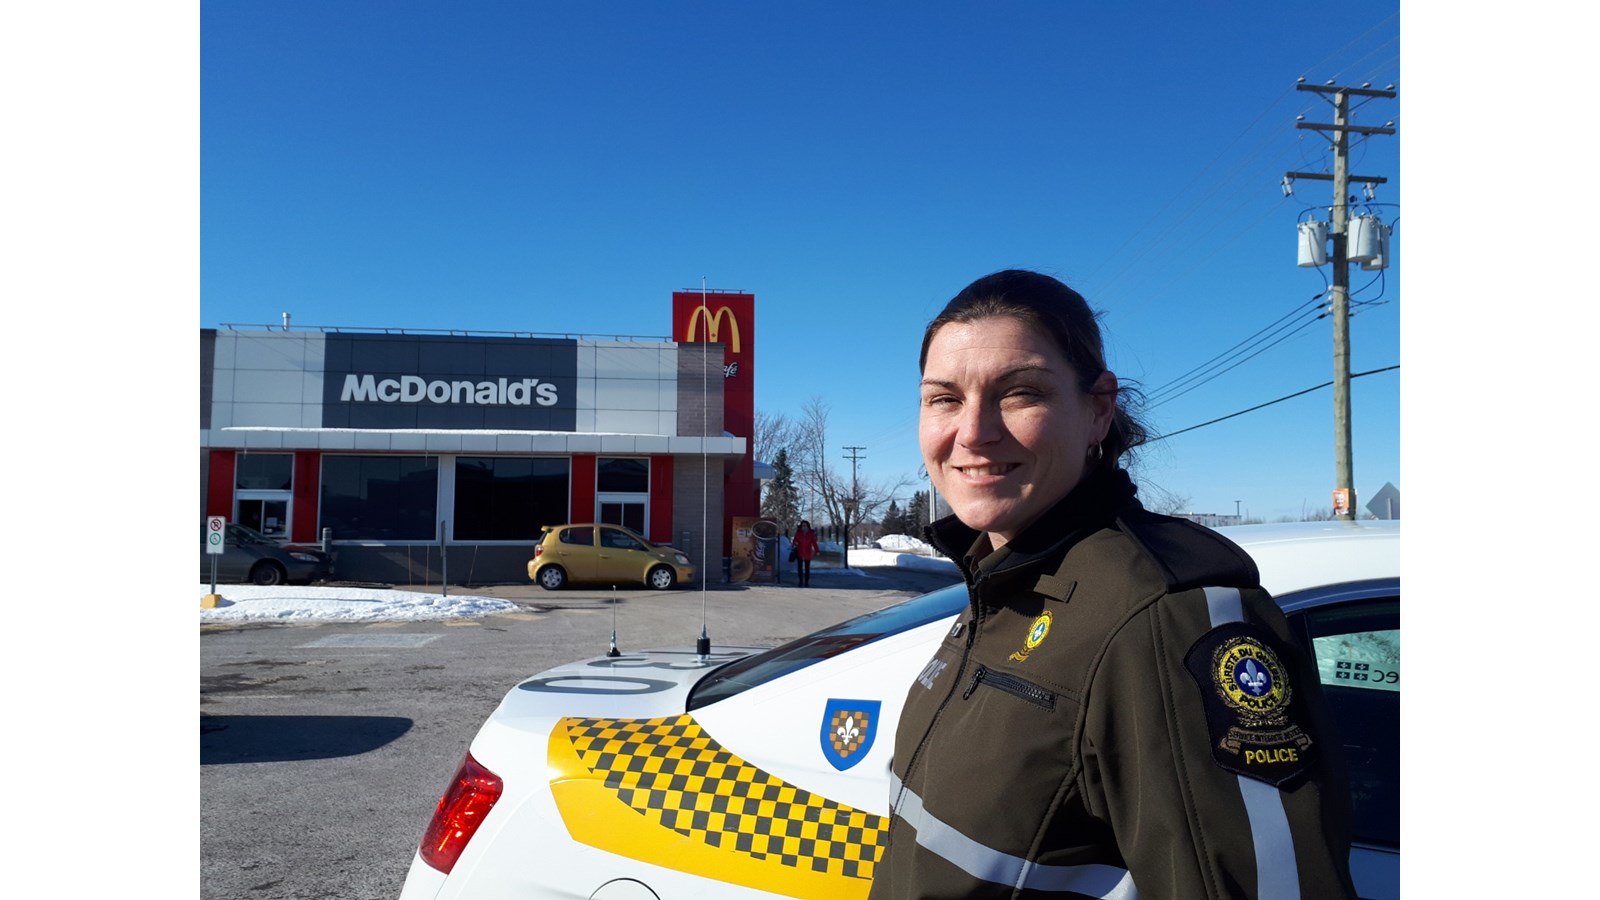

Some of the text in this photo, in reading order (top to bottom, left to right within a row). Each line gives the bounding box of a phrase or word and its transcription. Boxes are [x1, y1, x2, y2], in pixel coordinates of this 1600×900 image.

[340, 374, 559, 407] McDonald's
[1238, 647, 1252, 658] DU
[1239, 693, 1280, 710] POLICE
[1244, 748, 1298, 764] POLICE
